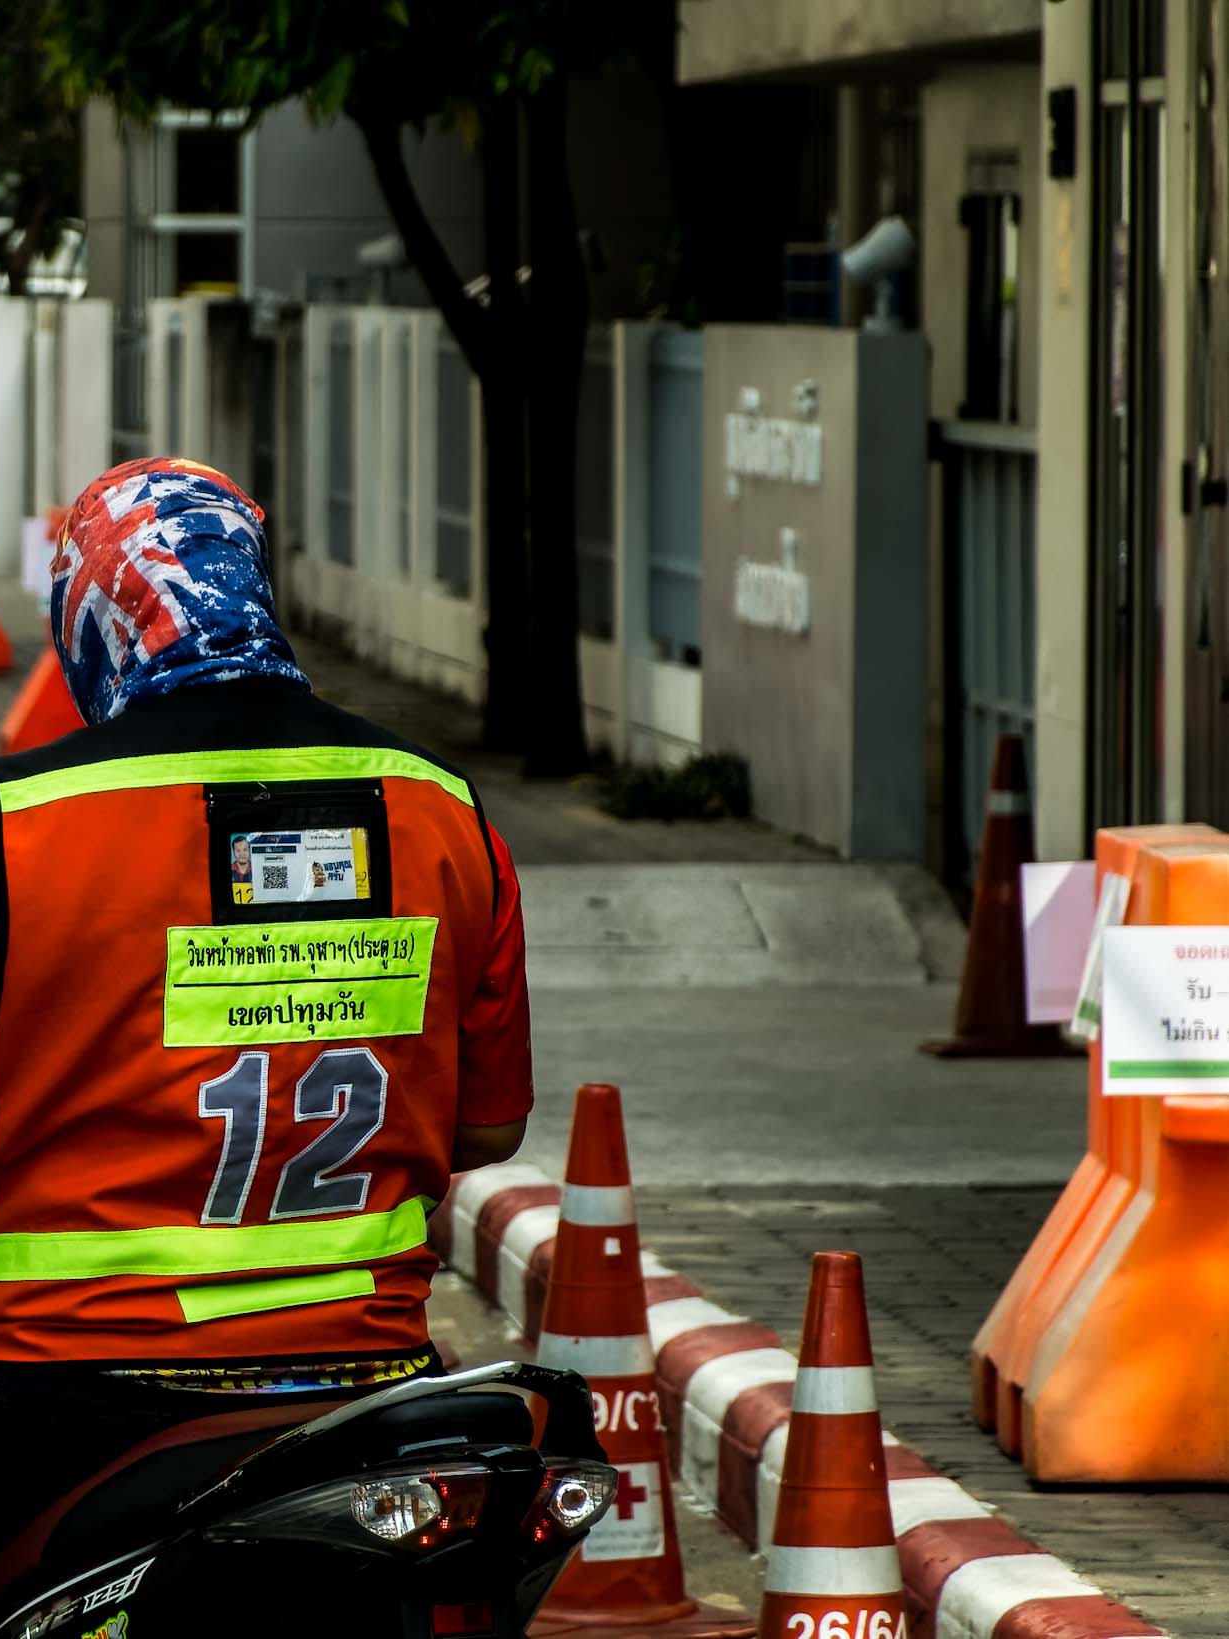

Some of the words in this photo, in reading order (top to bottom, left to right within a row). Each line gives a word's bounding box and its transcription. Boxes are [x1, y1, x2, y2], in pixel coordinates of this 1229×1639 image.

[228, 991, 365, 1035] เขตปทุมวัน
[198, 1047, 389, 1225] 12
